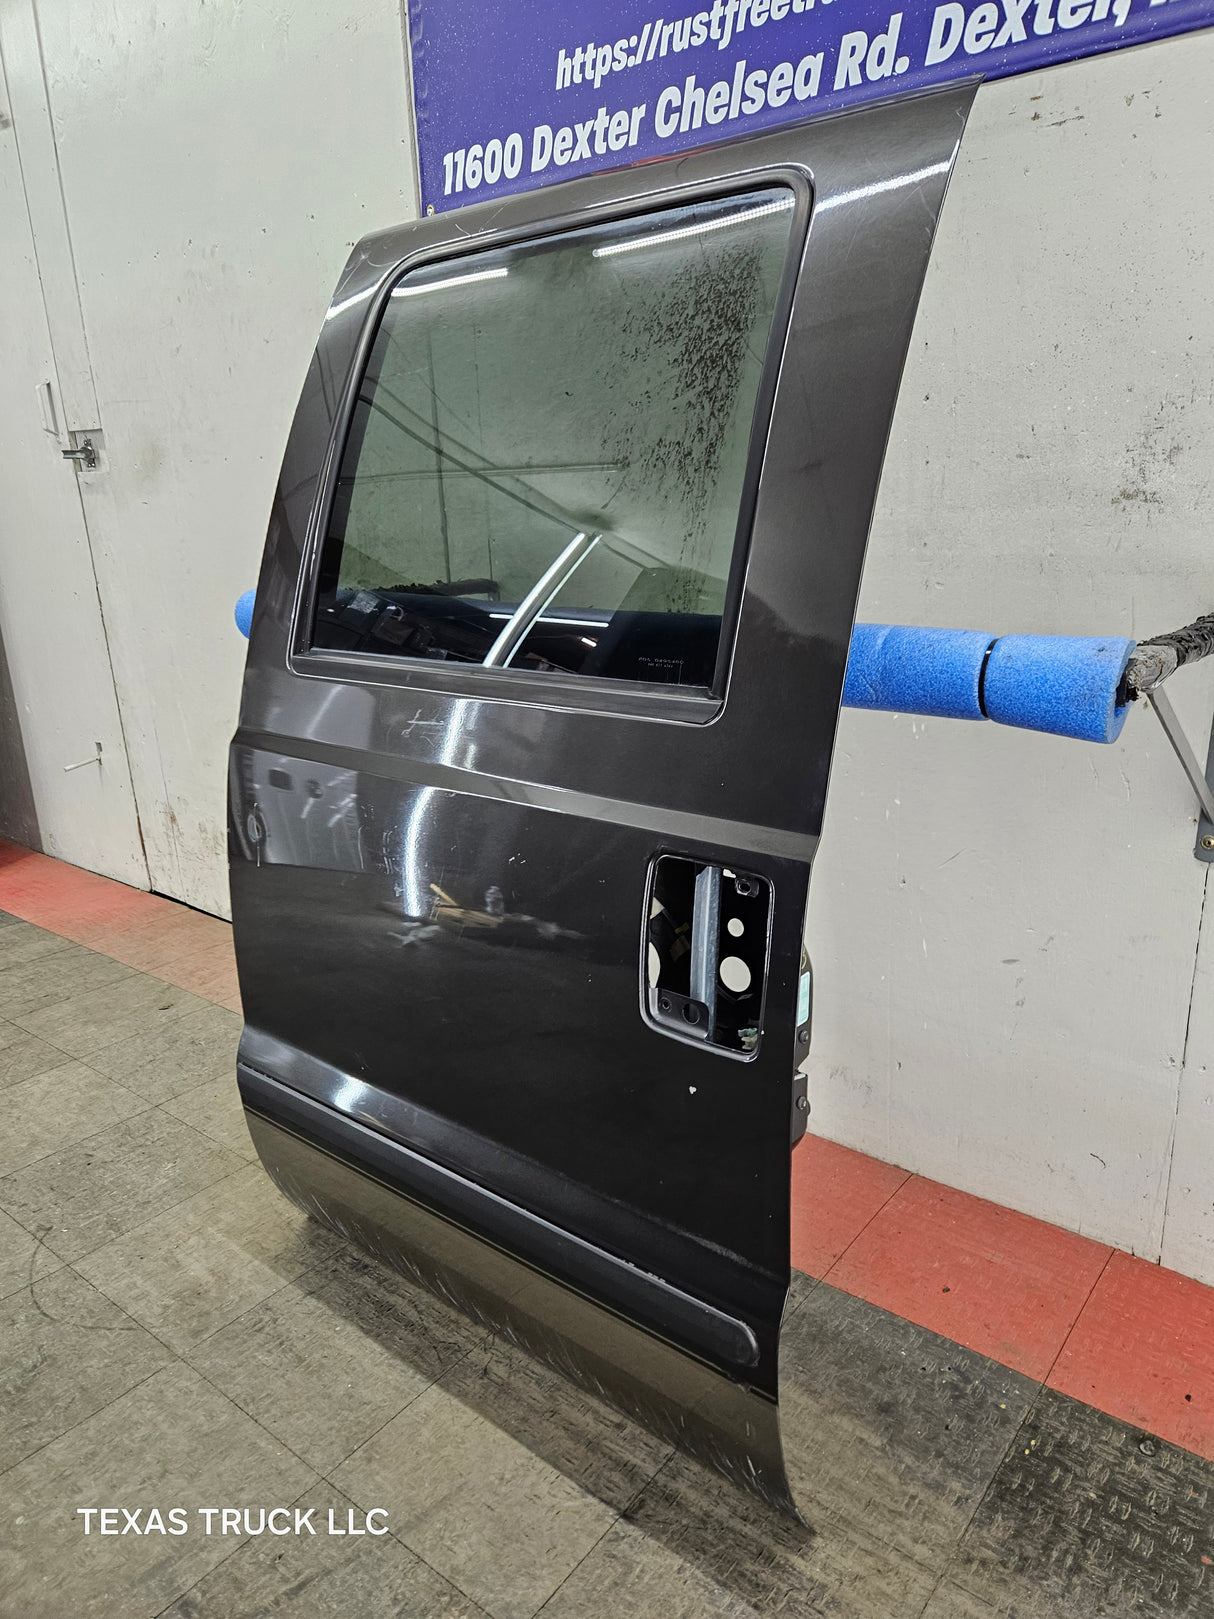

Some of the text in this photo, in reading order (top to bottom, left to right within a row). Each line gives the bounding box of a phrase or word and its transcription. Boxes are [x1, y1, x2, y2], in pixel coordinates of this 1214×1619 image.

[443, 132, 523, 196] 11600
[530, 103, 647, 173] Dexter
[654, 51, 825, 139] Chelsea
[833, 12, 910, 91] Rd.
